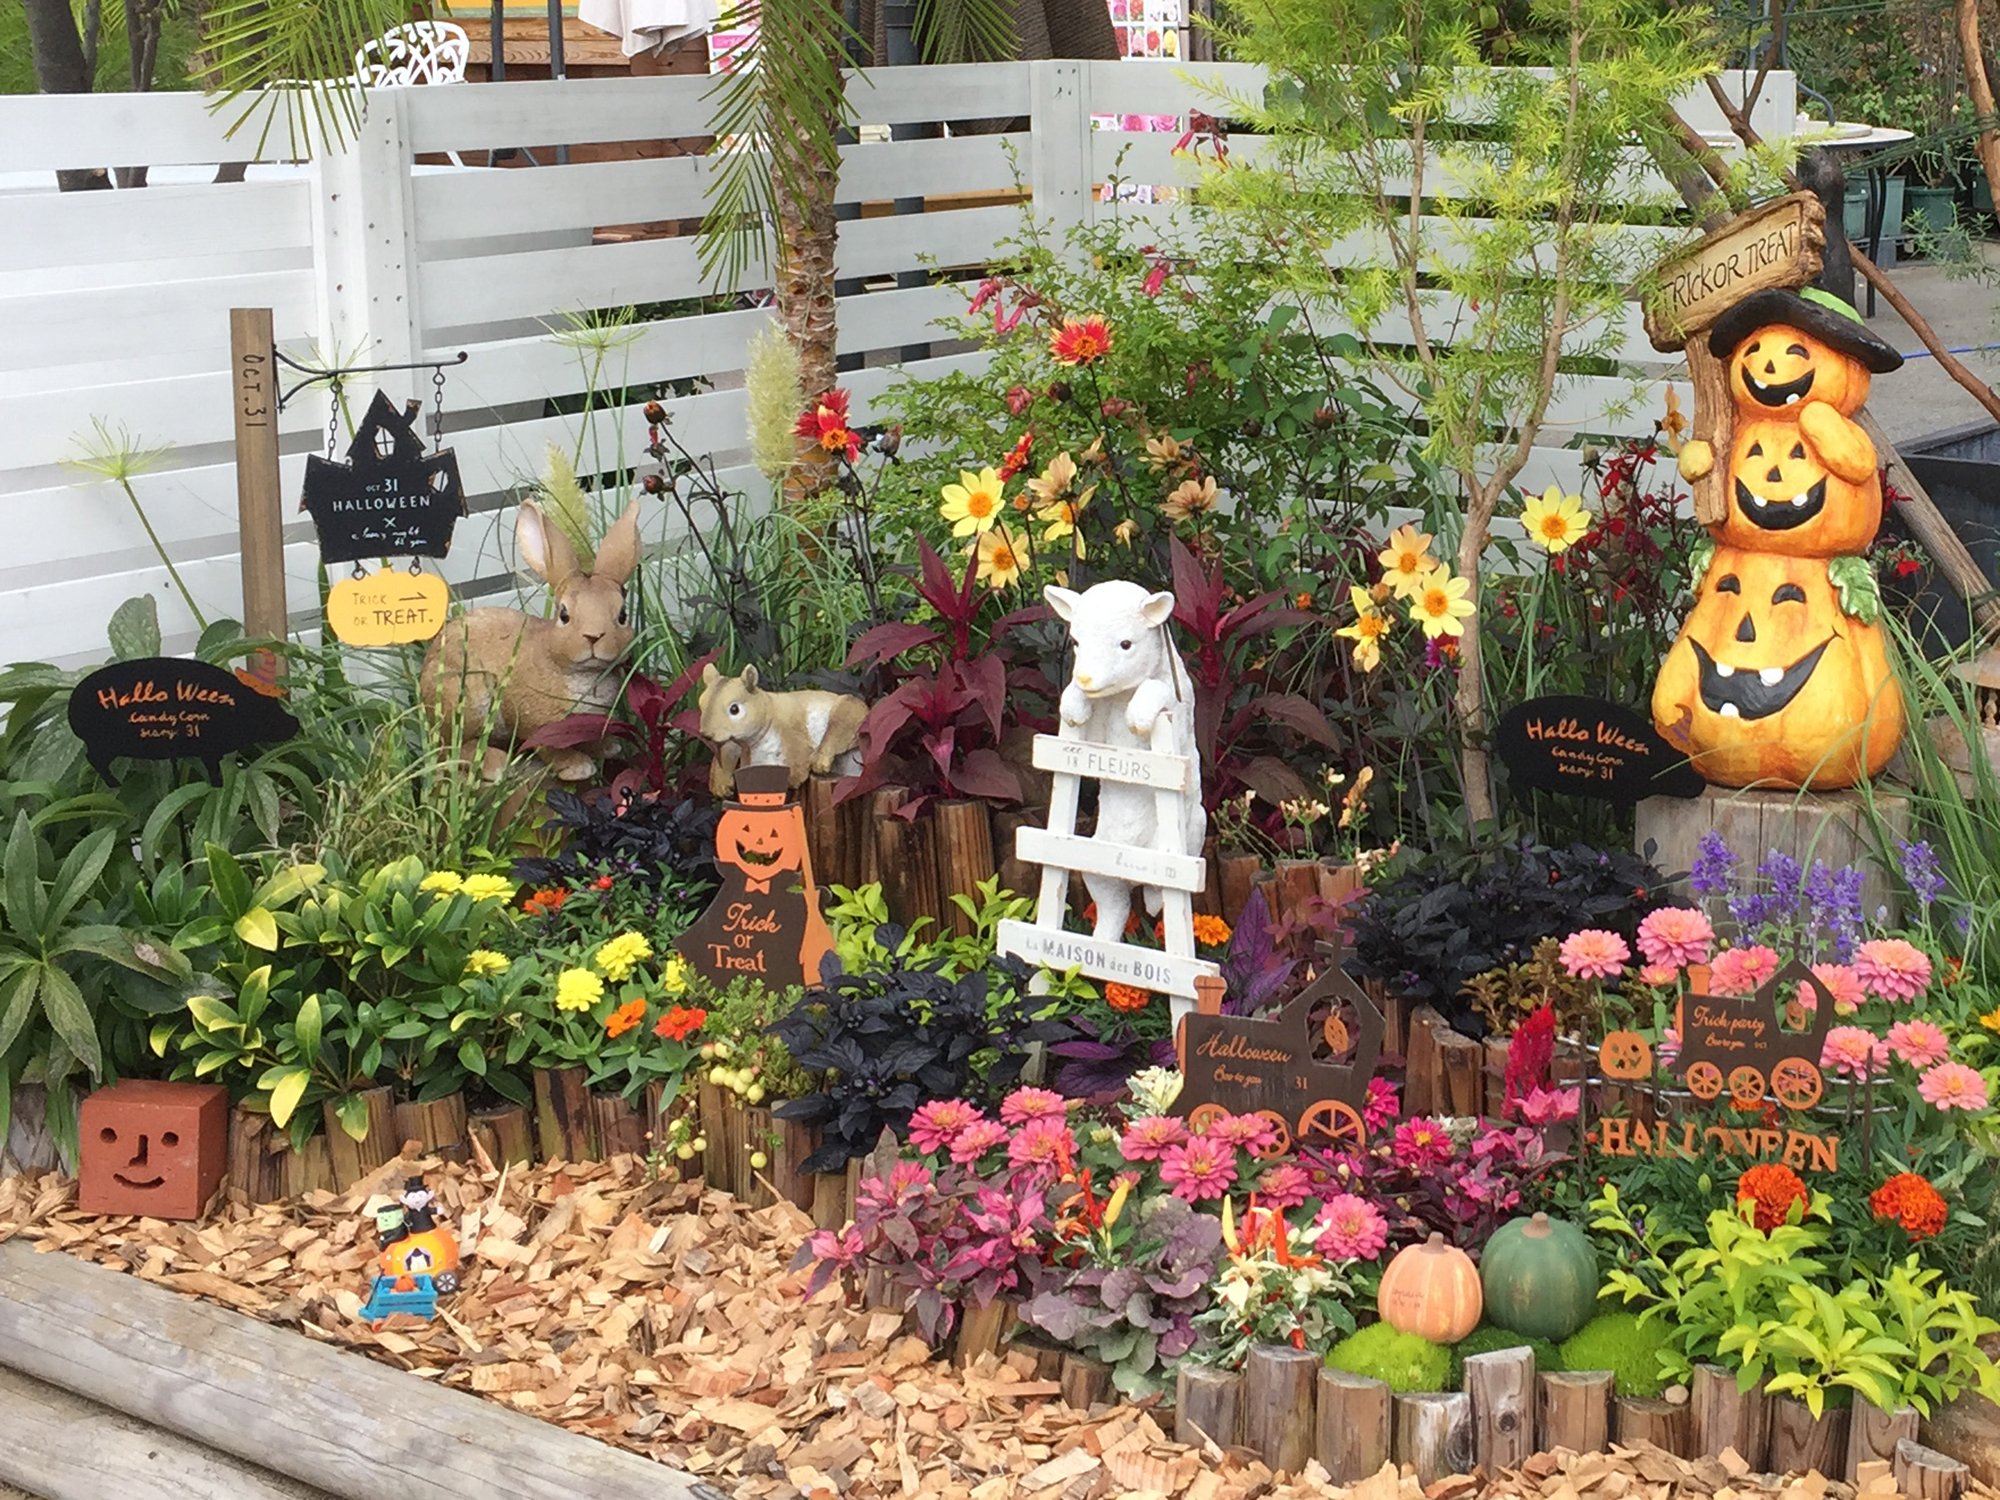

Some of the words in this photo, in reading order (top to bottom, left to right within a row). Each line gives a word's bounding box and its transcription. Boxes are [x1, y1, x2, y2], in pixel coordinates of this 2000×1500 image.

[1713, 253, 1744, 288] OR
[1745, 221, 1797, 275] TREAT
[384, 478, 398, 492] 31
[332, 495, 431, 512] HALLOWEEN
[352, 592, 387, 606] TRICK
[97, 681, 168, 709] Hallo
[176, 679, 236, 707] Ween
[186, 724, 201, 738] 31
[1526, 717, 1590, 741] Hallo
[1596, 720, 1650, 756] Ween
[1088, 753, 1151, 780] FLEURS
[1600, 766, 1614, 780] 31
[722, 902, 782, 933] Trick
[734, 934, 754, 949] or
[707, 943, 768, 973] Treat
[1041, 938, 1106, 969] MAISON
[1133, 961, 1172, 985] BOIS
[1196, 1030, 1293, 1063] Halloween
[1295, 1075, 1308, 1090] 31
